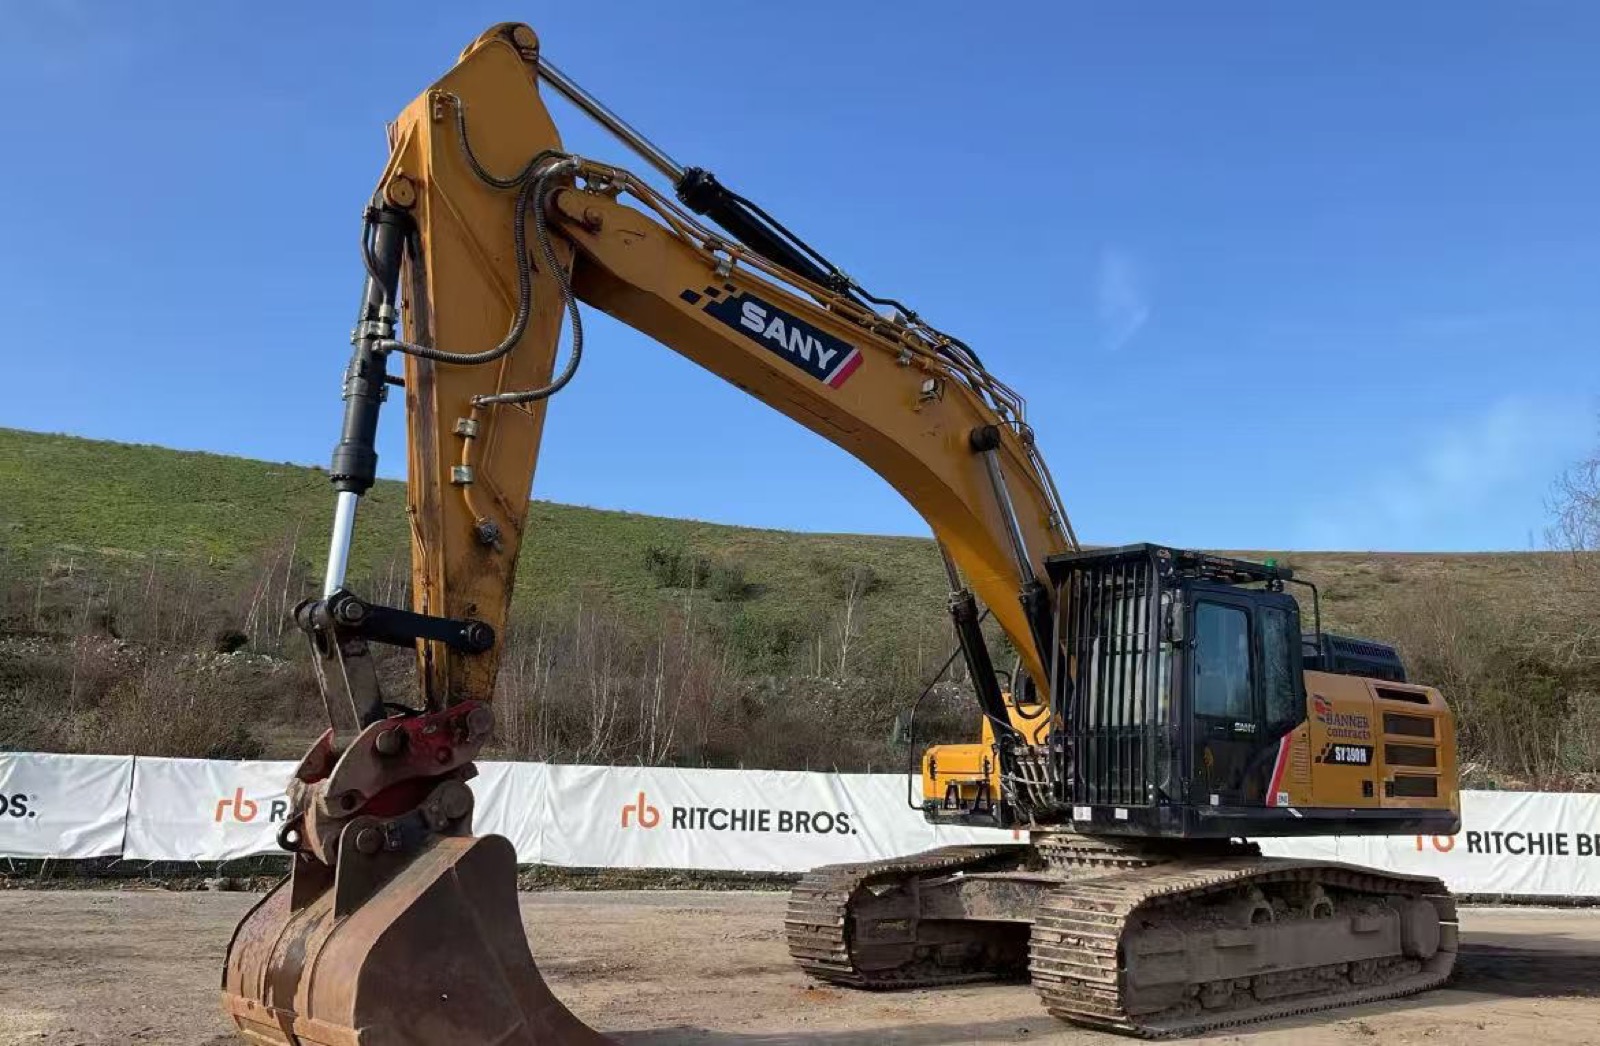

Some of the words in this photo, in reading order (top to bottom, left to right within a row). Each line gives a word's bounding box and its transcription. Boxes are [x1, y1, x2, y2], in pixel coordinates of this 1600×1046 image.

[740, 301, 837, 370] SANY
[215, 787, 258, 822] rb
[621, 791, 660, 829] rb
[672, 806, 770, 832] RITCHIE
[778, 811, 857, 835] BROS.
[1466, 831, 1569, 856] RITCHIE
